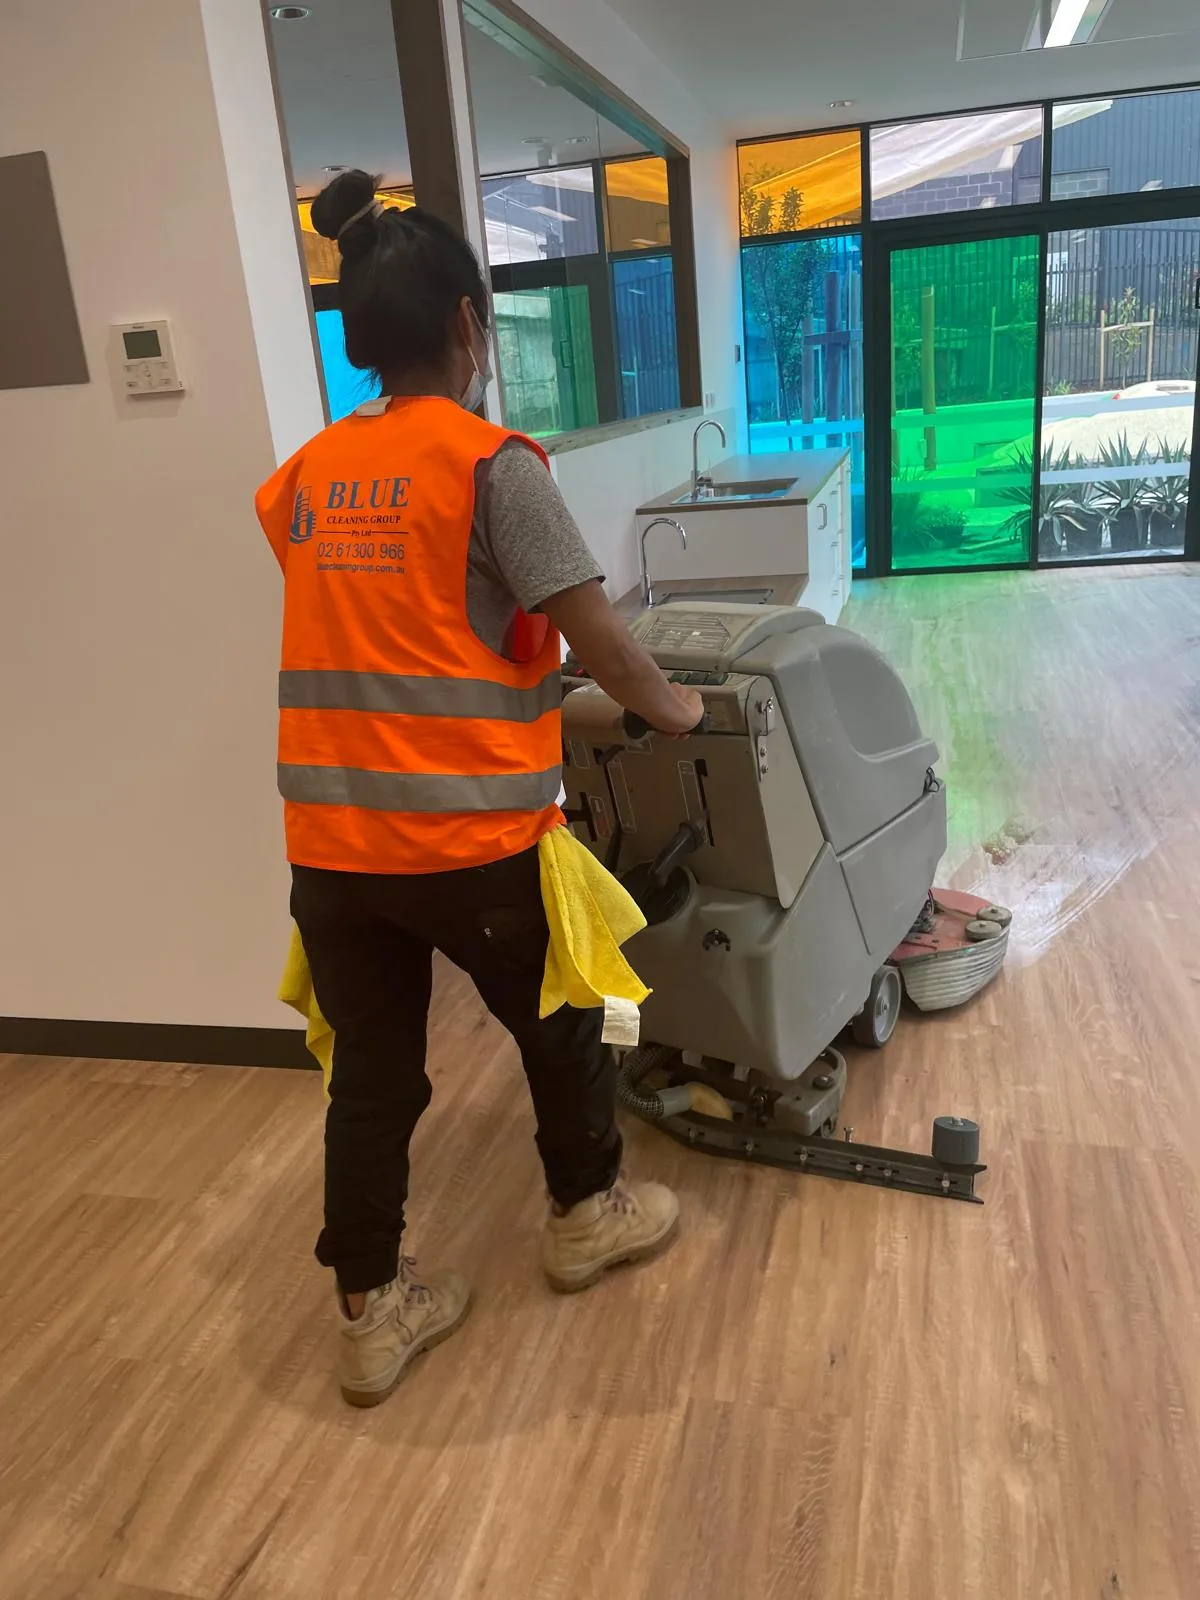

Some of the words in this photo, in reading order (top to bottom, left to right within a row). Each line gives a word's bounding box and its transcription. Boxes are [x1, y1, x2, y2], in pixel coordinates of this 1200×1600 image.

[321, 477, 410, 509] BLUE
[327, 515, 369, 525] CLEANING
[371, 515, 401, 524] GROUP
[318, 542, 333, 558] 02
[380, 544, 405, 560] 966
